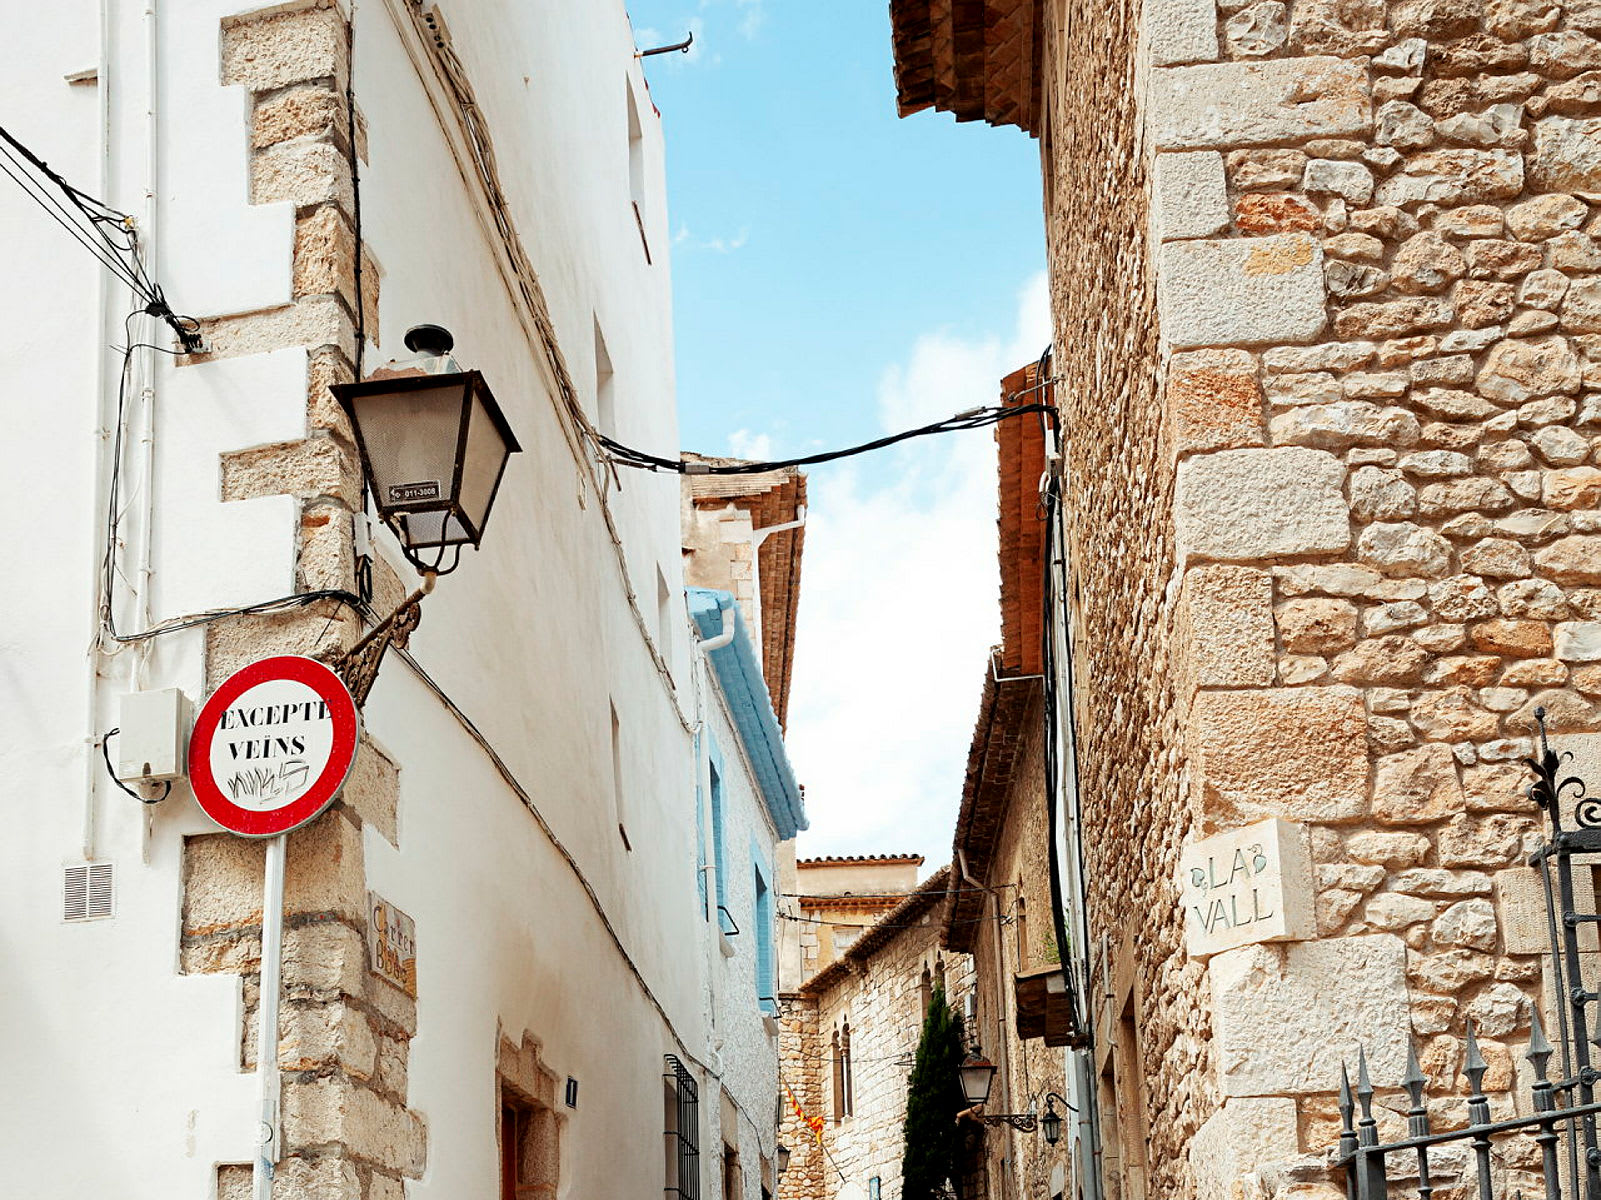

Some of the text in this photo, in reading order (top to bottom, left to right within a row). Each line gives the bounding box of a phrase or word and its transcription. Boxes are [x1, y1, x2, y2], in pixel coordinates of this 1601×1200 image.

[220, 700, 333, 730] EXCEPTE
[228, 735, 305, 760] VEÏNS
[1209, 849, 1251, 889] LA
[373, 905, 414, 955] Carrer
[1193, 889, 1274, 934] VALL
